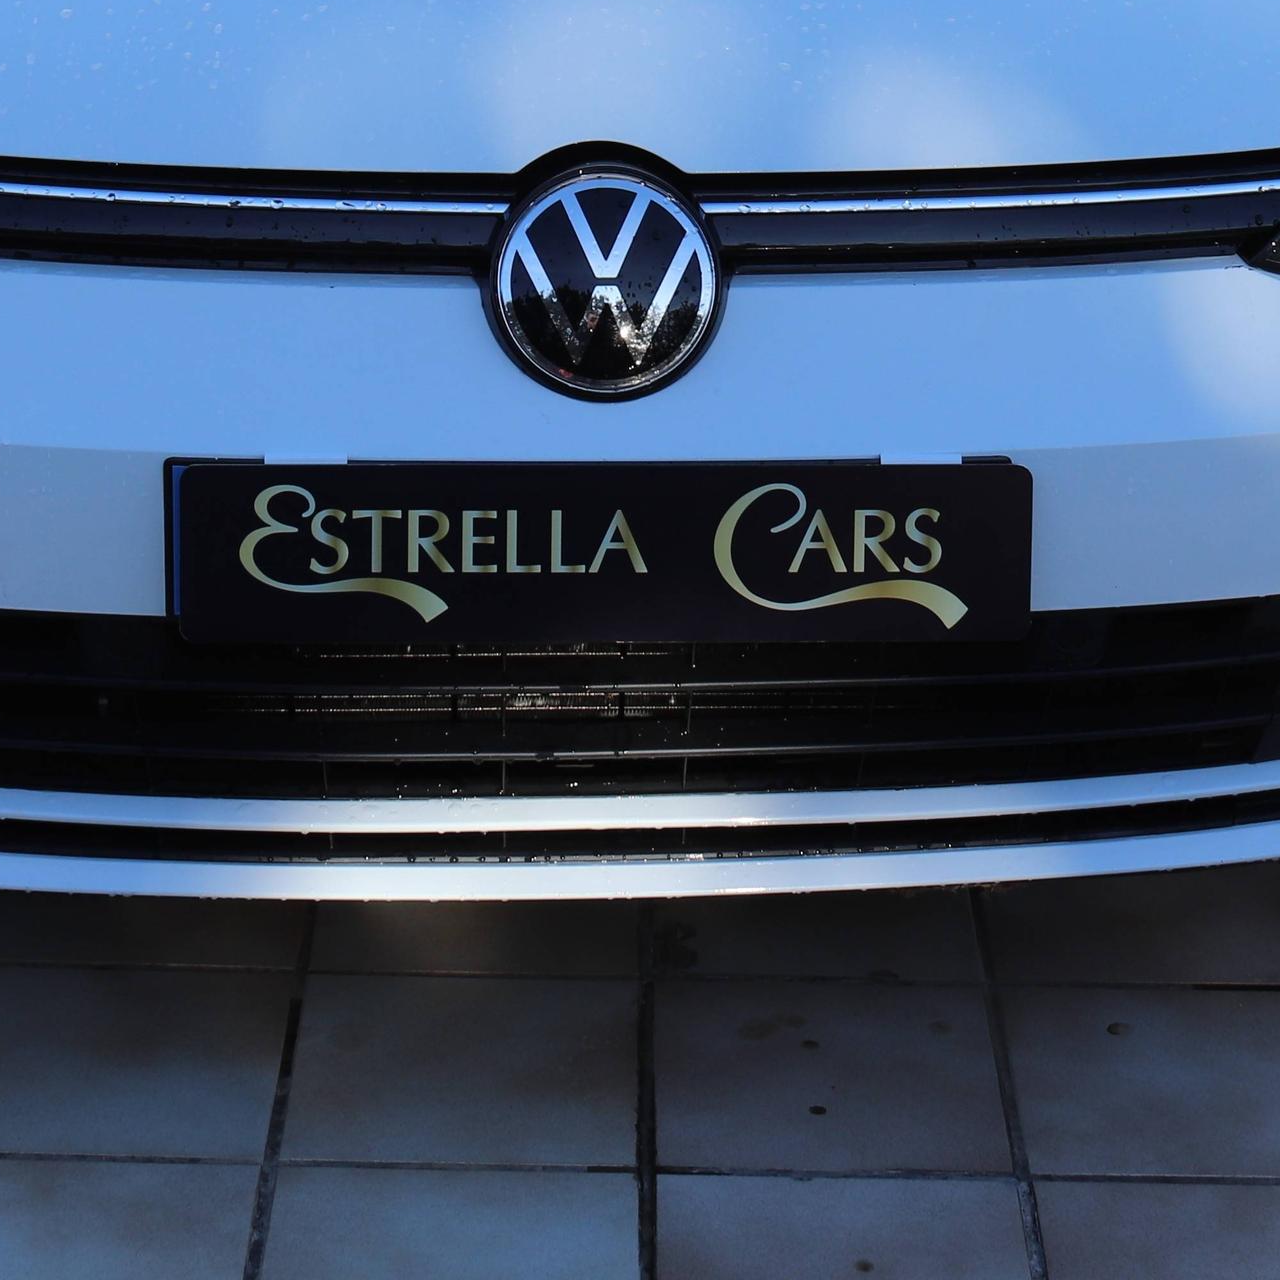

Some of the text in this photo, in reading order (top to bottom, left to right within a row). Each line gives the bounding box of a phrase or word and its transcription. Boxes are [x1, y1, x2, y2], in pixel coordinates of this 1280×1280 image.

[508, 179, 706, 375] VW
[239, 483, 969, 630] ESTRELLA CARS
